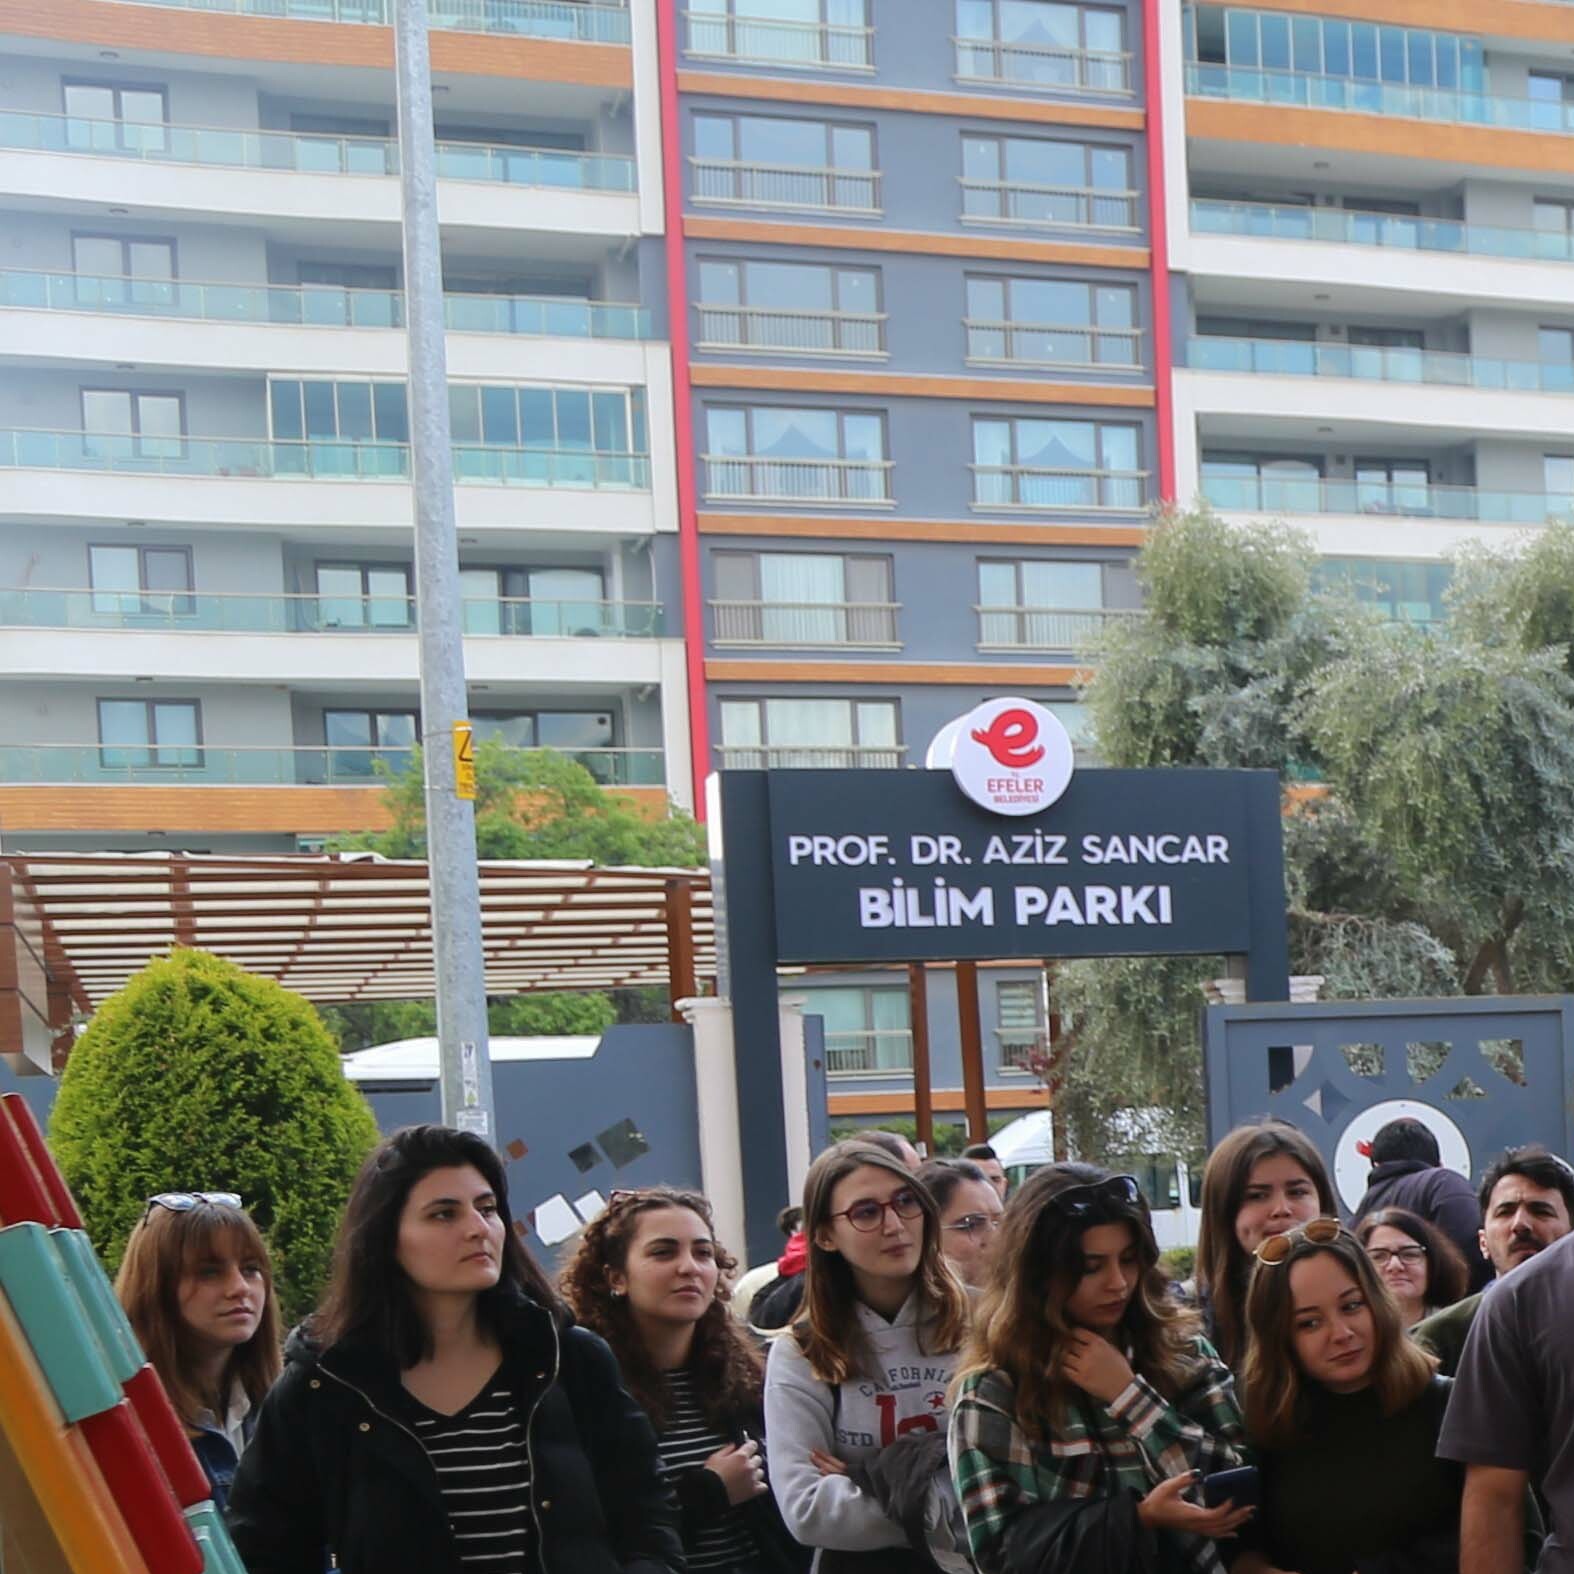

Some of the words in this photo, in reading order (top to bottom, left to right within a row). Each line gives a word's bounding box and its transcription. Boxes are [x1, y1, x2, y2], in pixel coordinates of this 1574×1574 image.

[987, 778, 1044, 794] EFELER
[788, 834, 897, 866] PROF.
[910, 834, 972, 865] DR.
[982, 828, 1069, 865] AZİZ
[1081, 834, 1230, 865] SANCAR
[858, 876, 995, 928] BİLİM
[1014, 885, 1173, 926] PARKI
